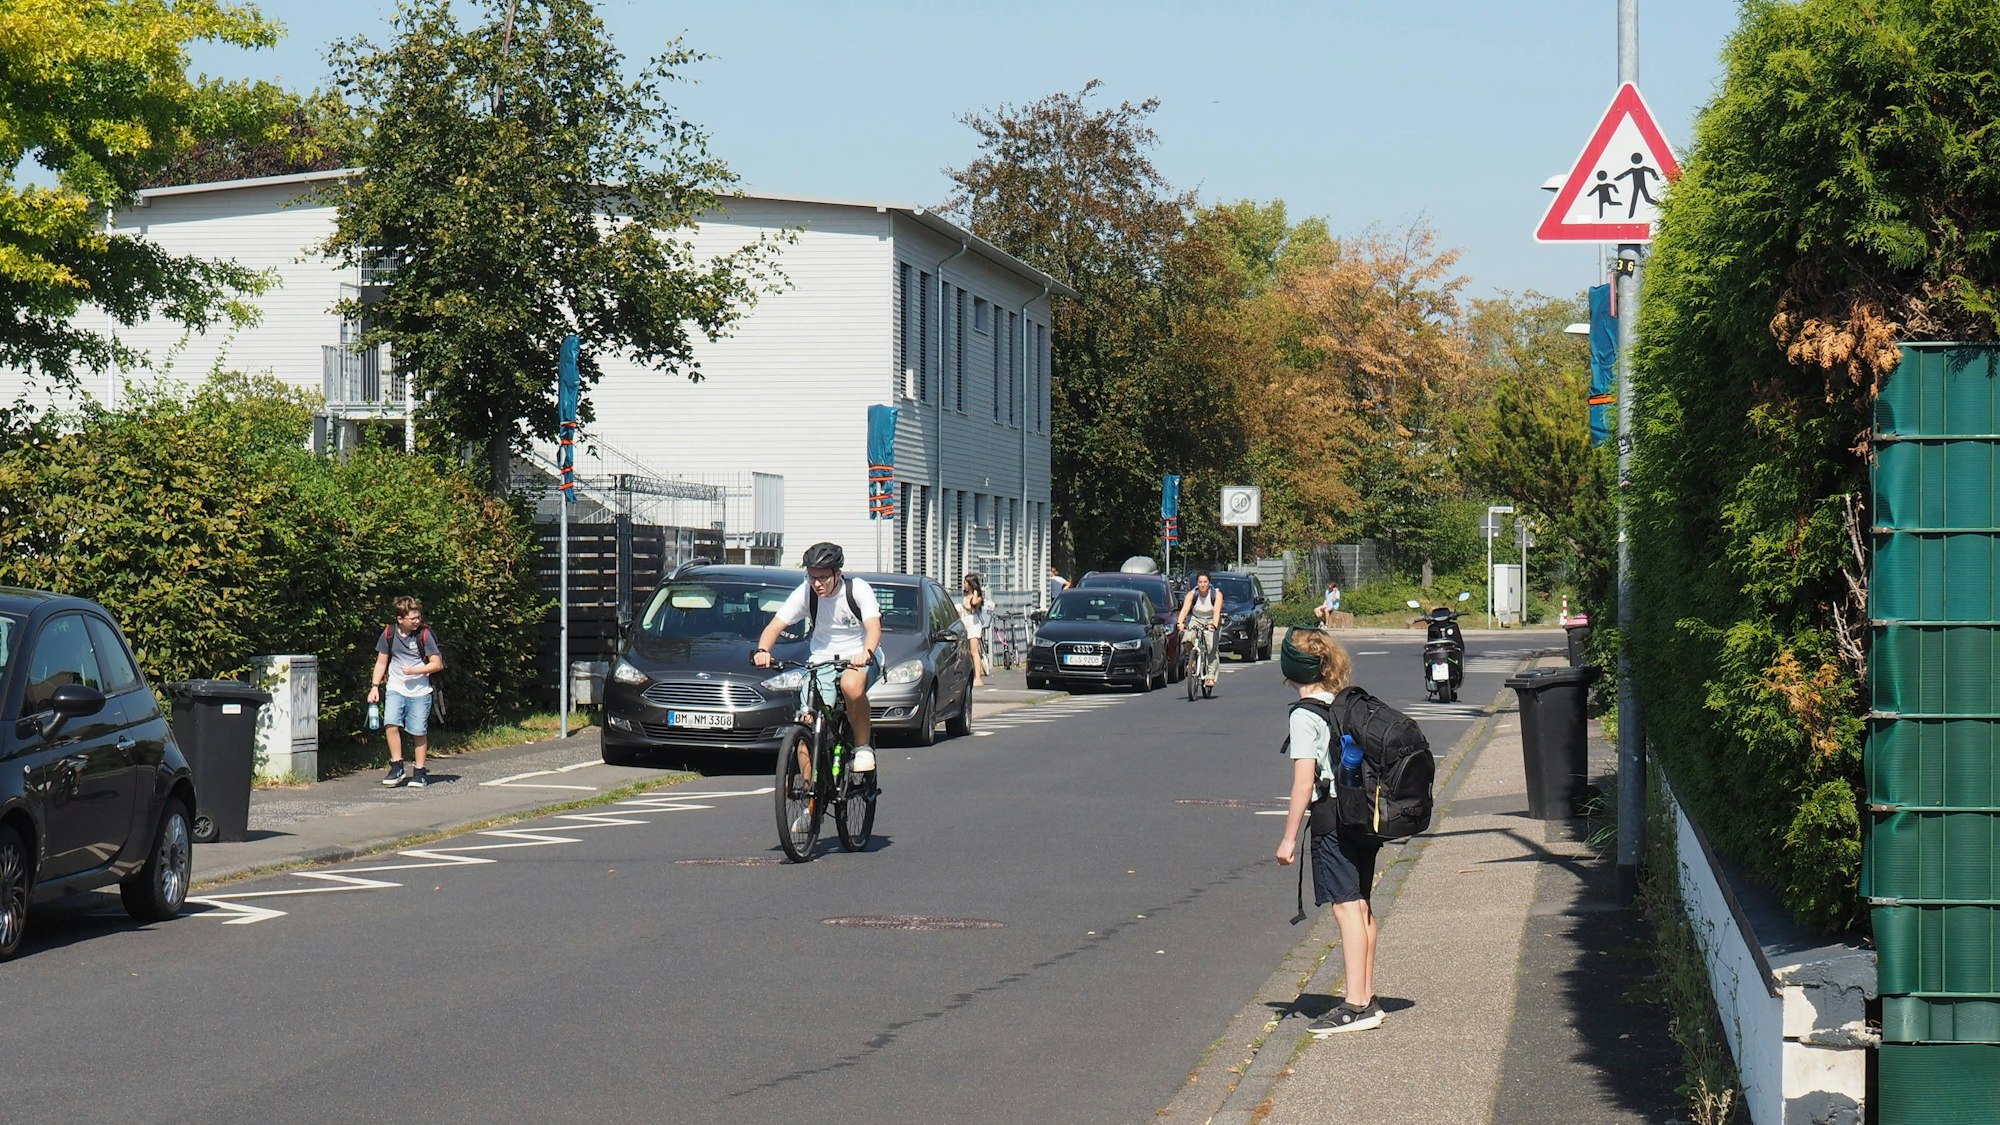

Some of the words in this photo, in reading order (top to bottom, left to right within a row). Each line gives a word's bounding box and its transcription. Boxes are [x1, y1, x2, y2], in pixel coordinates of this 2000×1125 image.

[1233, 496, 1248, 508] 30
[675, 713, 688, 724] BM
[694, 714, 707, 725] NM
[708, 715, 732, 726] 3308
